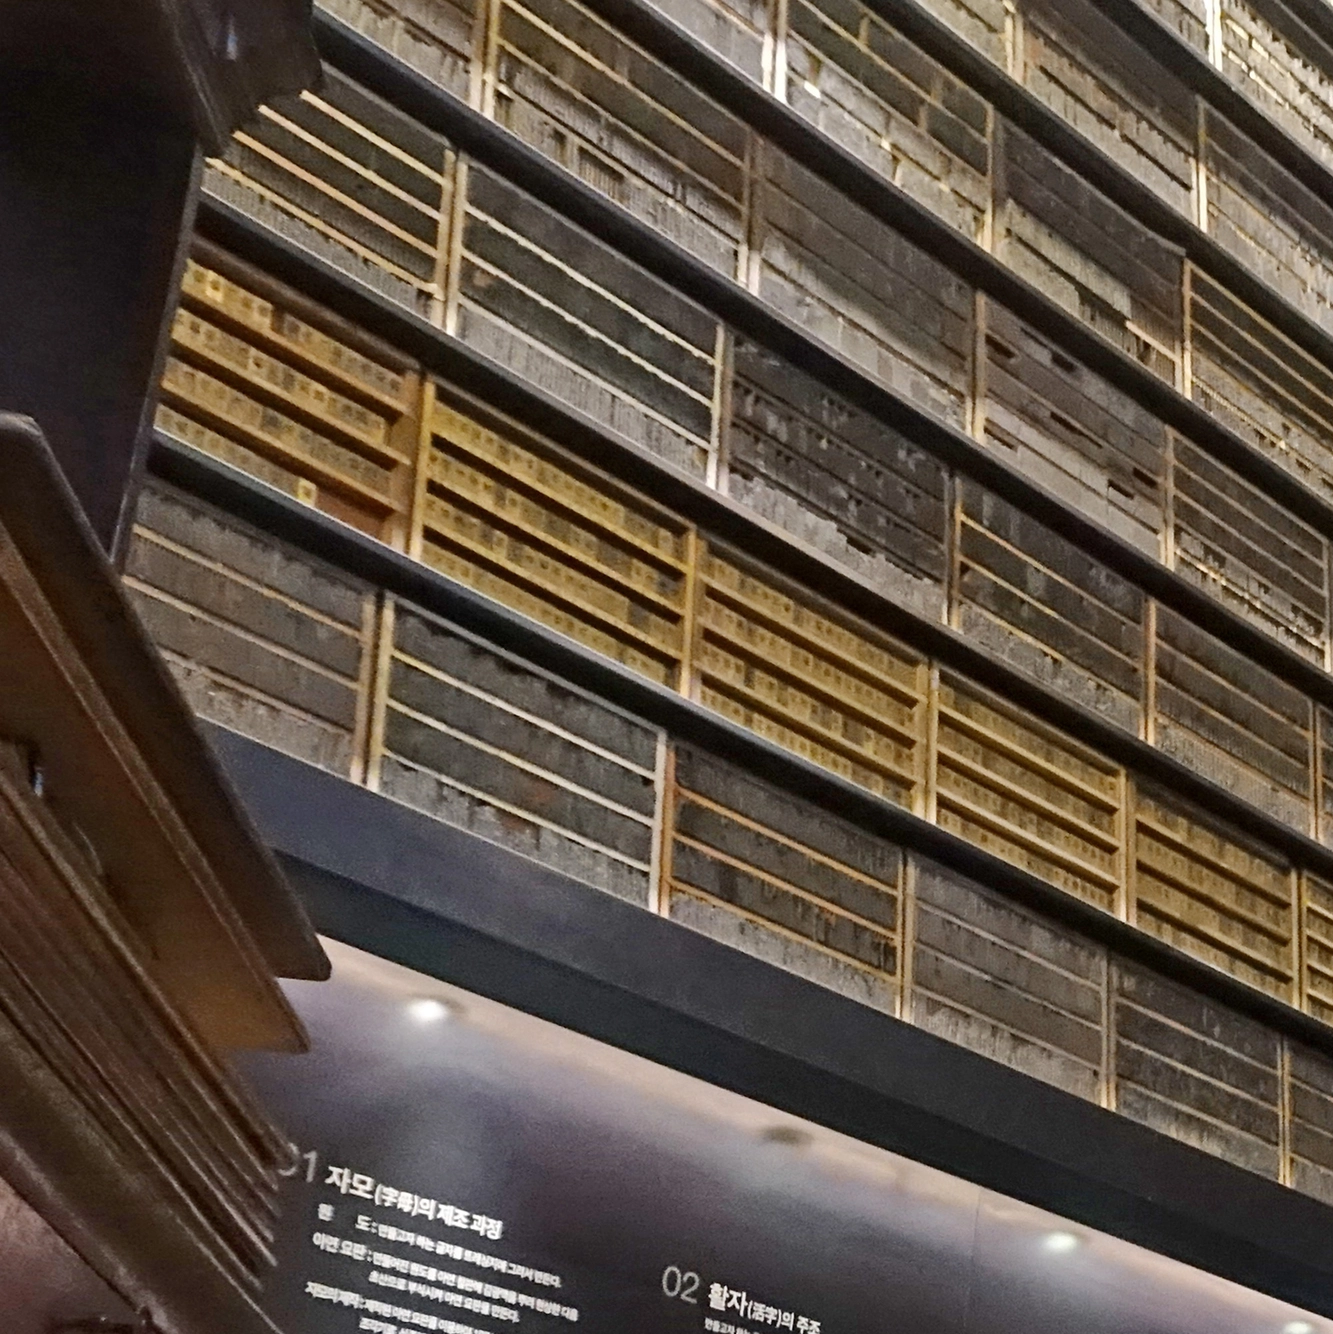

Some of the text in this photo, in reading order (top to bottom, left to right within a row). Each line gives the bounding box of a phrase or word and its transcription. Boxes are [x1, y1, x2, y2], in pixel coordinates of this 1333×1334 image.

[436, 1203, 470, 1229] 제조
[470, 1214, 503, 1240] 과정
[662, 1266, 700, 1304] 02
[708, 1283, 794, 1331] 활자(活字)의
